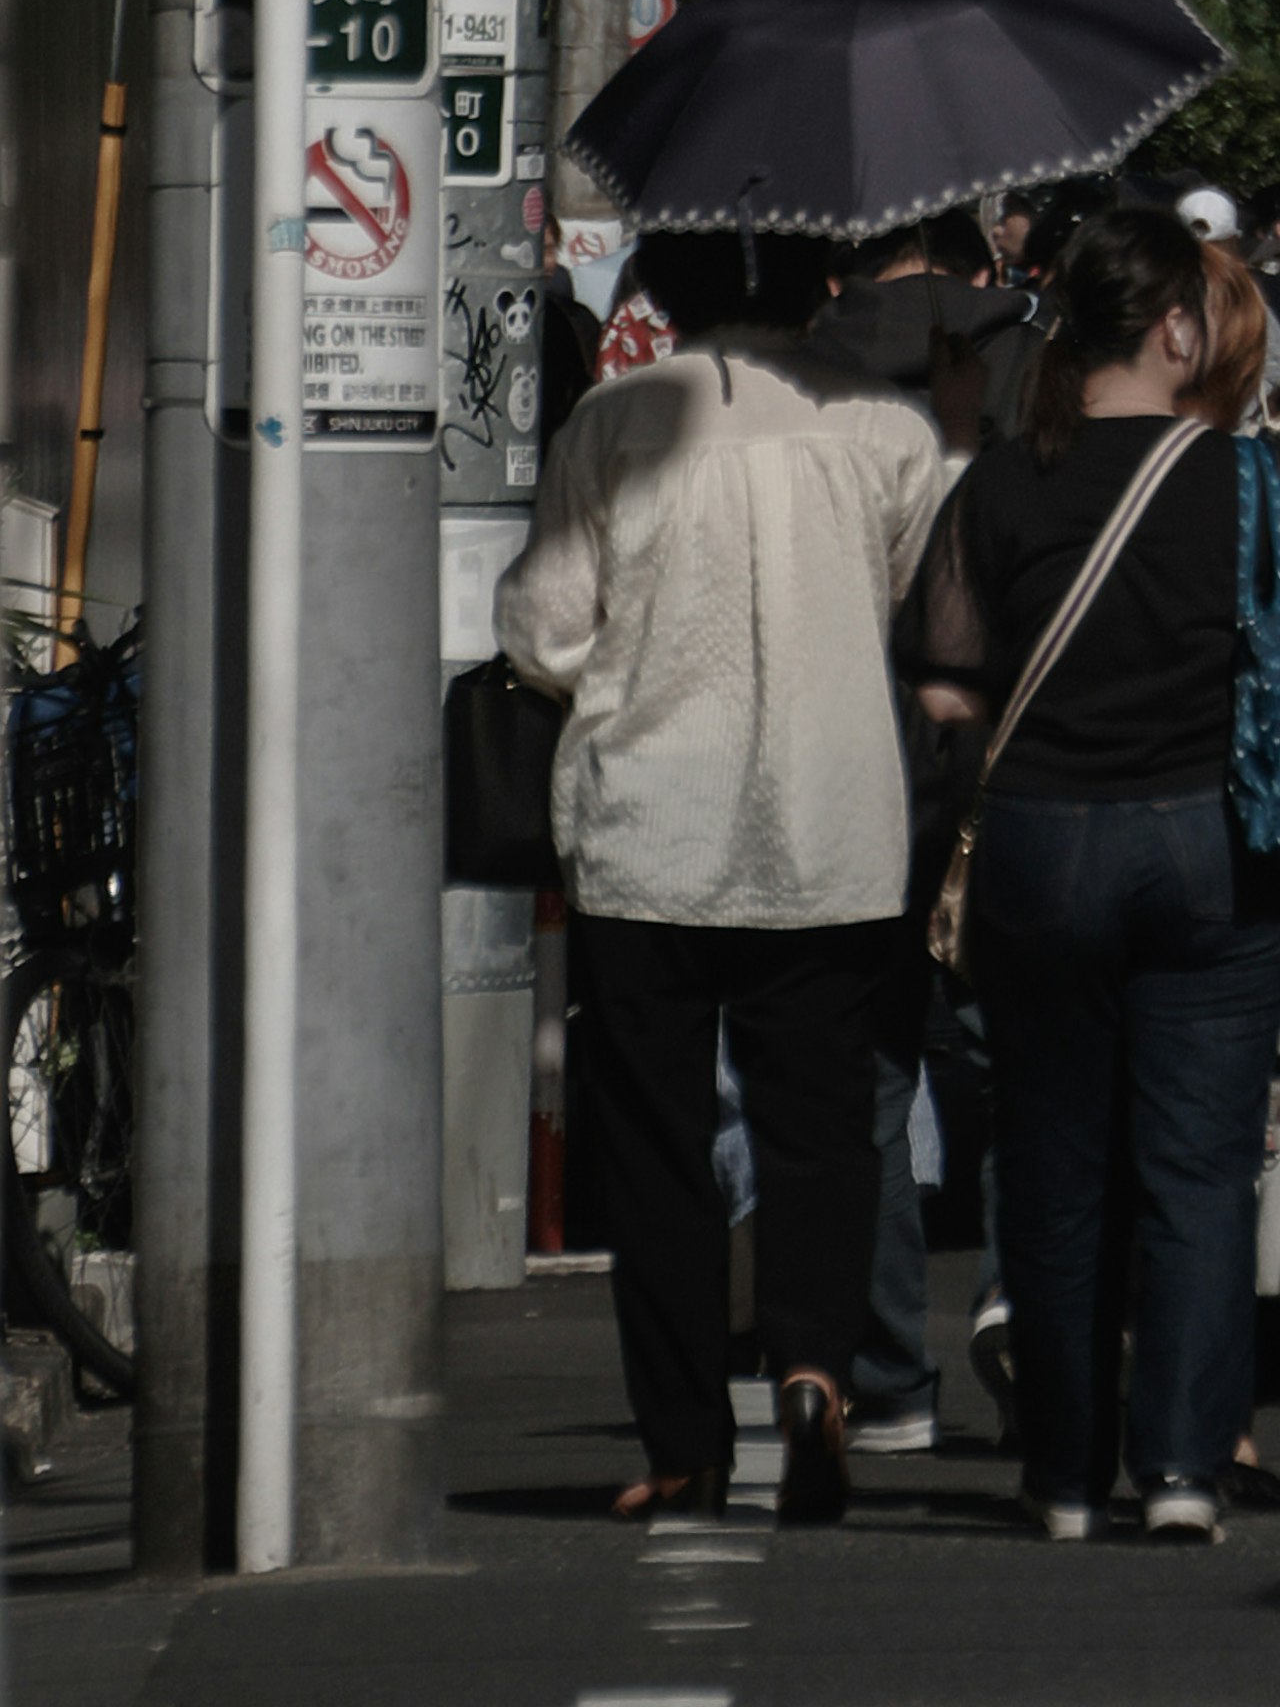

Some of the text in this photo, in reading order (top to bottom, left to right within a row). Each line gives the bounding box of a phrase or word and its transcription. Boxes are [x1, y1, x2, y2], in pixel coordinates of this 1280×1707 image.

[305, 15, 399, 63] -10
[444, 13, 505, 42] 1-9431
[309, 218, 408, 278] SMOKING
[330, 324, 355, 347] ON
[359, 325, 388, 347] THE
